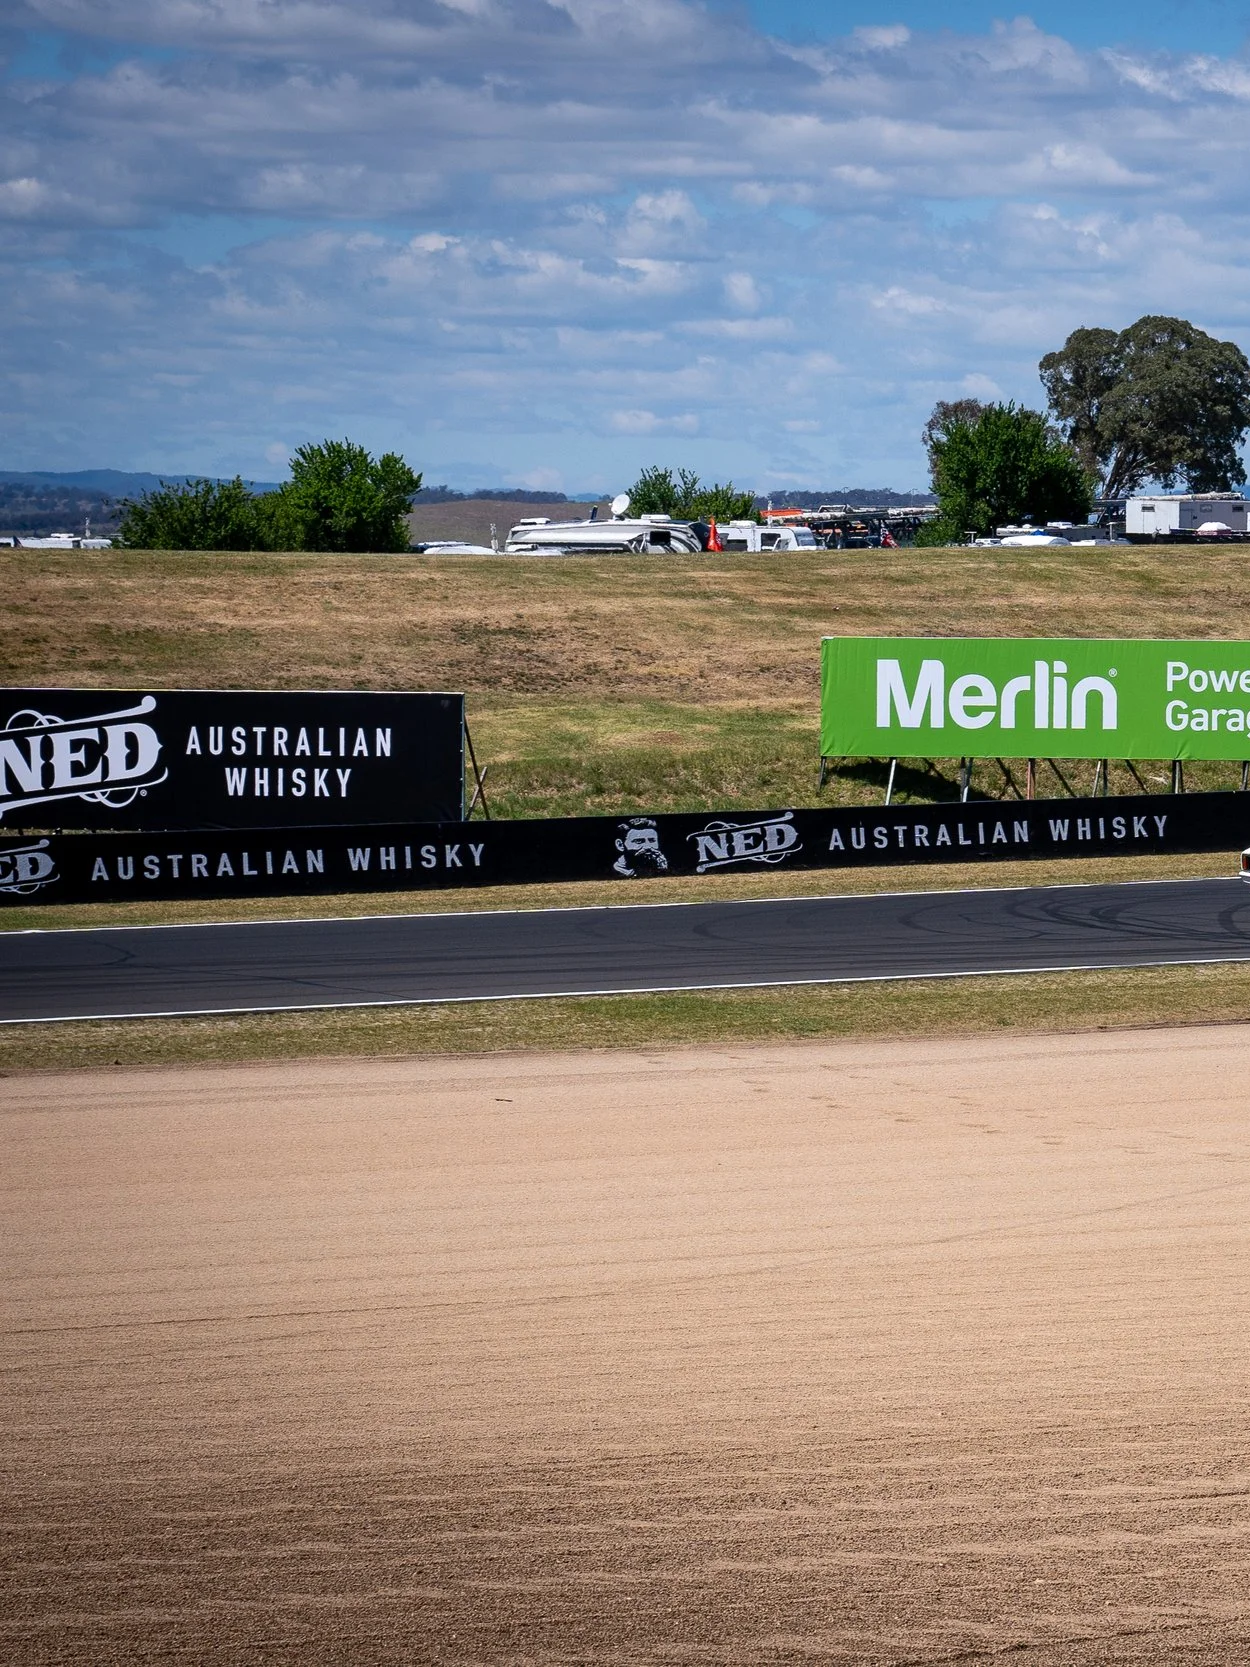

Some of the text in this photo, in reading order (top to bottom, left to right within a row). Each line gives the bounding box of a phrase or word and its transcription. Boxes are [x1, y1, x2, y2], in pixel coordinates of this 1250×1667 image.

[876, 659, 1117, 729] Merlin
[0, 722, 163, 796] NED
[186, 726, 391, 756] AUSTRALIAN
[225, 768, 351, 797] WHISKY
[695, 816, 1167, 862] NED AUSTRALIAN WHISKY
[92, 850, 323, 880] AUSTRALIAN
[348, 844, 484, 871] WHISKY
